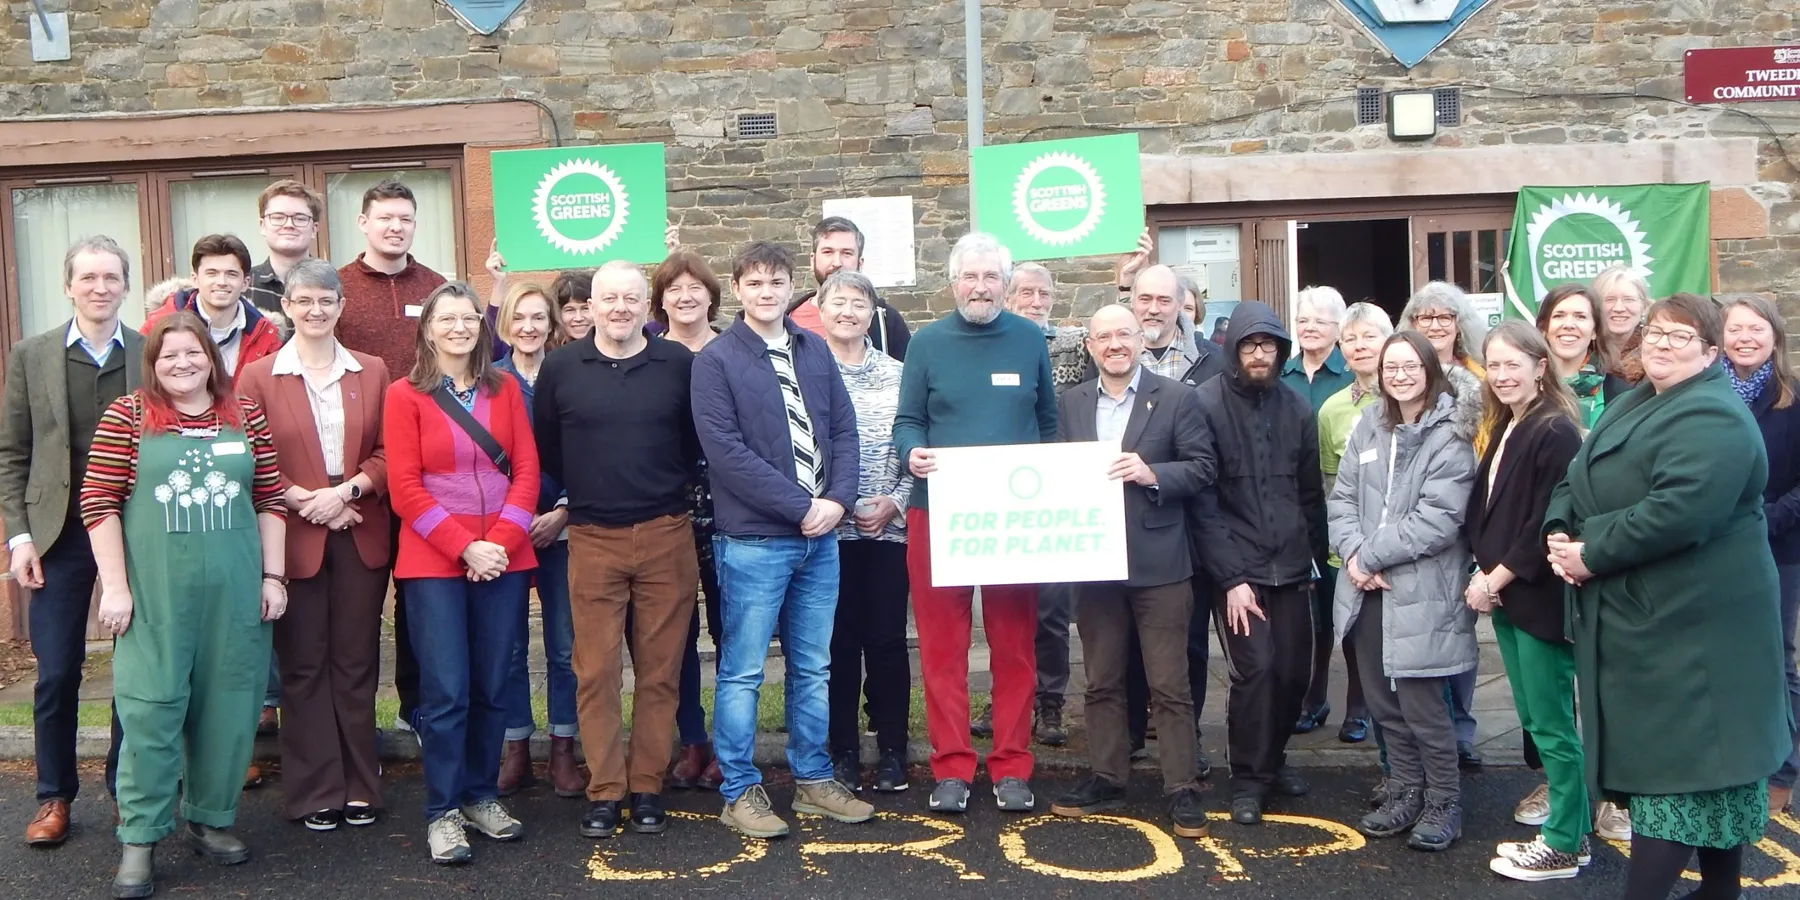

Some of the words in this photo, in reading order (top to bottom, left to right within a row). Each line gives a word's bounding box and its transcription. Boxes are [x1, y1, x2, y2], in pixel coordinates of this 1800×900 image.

[1713, 84, 1800, 99] COMMUNIT
[1030, 185, 1086, 197] SCOTTISH
[551, 193, 609, 205] SCOTTISH
[1030, 197, 1087, 212] GREENS
[551, 205, 611, 219] GREENS
[1543, 243, 1624, 258] SCOTTISH
[1543, 259, 1624, 279] GREEN
[949, 511, 998, 532] FOR
[1005, 507, 1106, 530] PEOPLE.
[949, 536, 998, 557] FOR
[585, 809, 1367, 881] DROP
